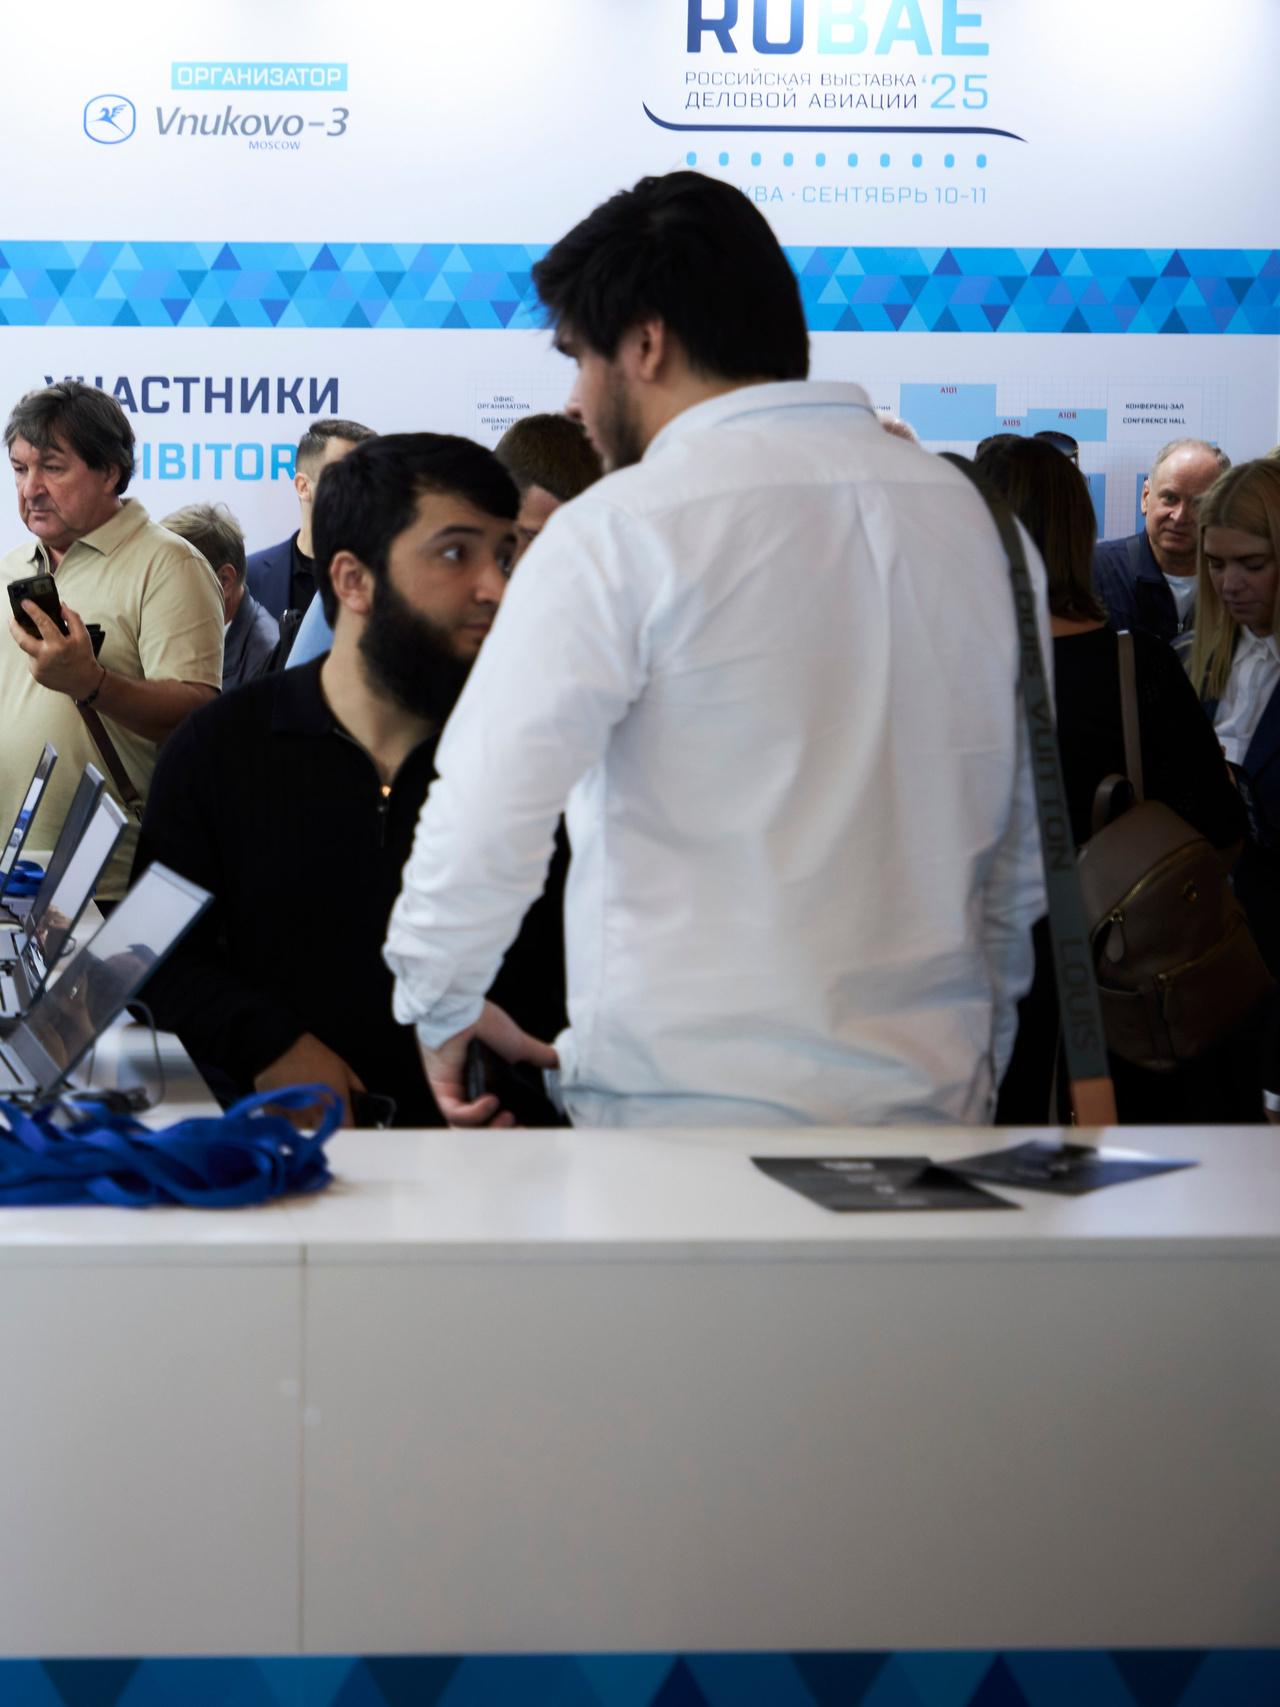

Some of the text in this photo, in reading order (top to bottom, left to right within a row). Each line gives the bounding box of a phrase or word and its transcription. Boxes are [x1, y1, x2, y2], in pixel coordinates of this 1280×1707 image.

[177, 67, 342, 86] ОРГАНИЗАТОР
[685, 69, 917, 87] РОССИЙСКАЯ ВЫСТАВКА
[685, 88, 918, 111] ДЕЛОВОЙ АВИАЦИИ
[248, 141, 301, 151] MOSCOW
[739, 185, 987, 205] КВА СЕНТЯБРЬ 10-11
[44, 376, 339, 414] АСТНИКИ
[133, 443, 298, 480] IBITOR
